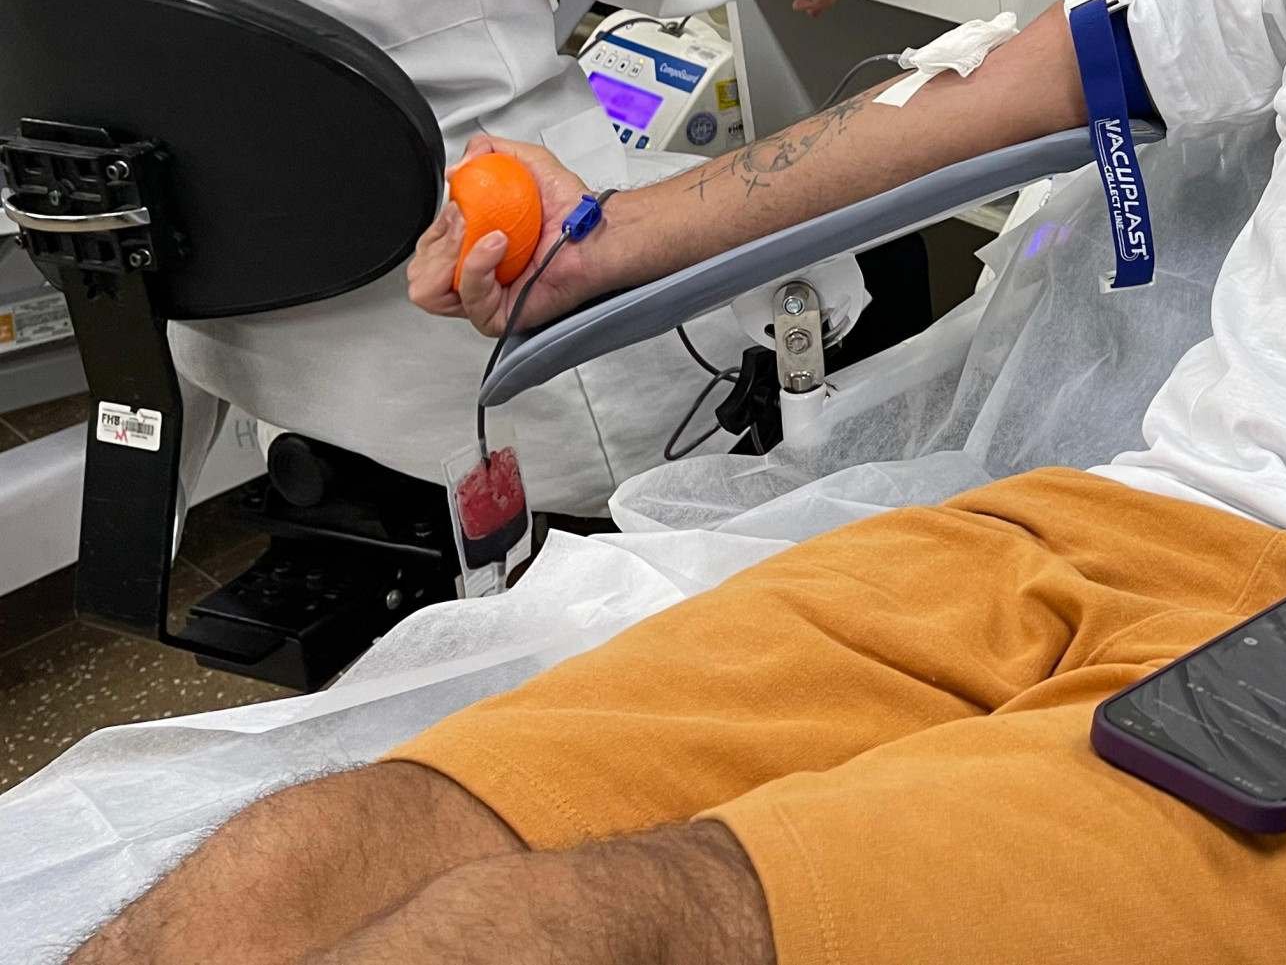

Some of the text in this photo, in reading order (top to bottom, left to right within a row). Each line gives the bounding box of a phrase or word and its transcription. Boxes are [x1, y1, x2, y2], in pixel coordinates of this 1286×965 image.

[1104, 165, 1124, 230] COLLECT LINE
[1105, 119, 1146, 260] VACUPLAST
[102, 413, 120, 426] FHB
